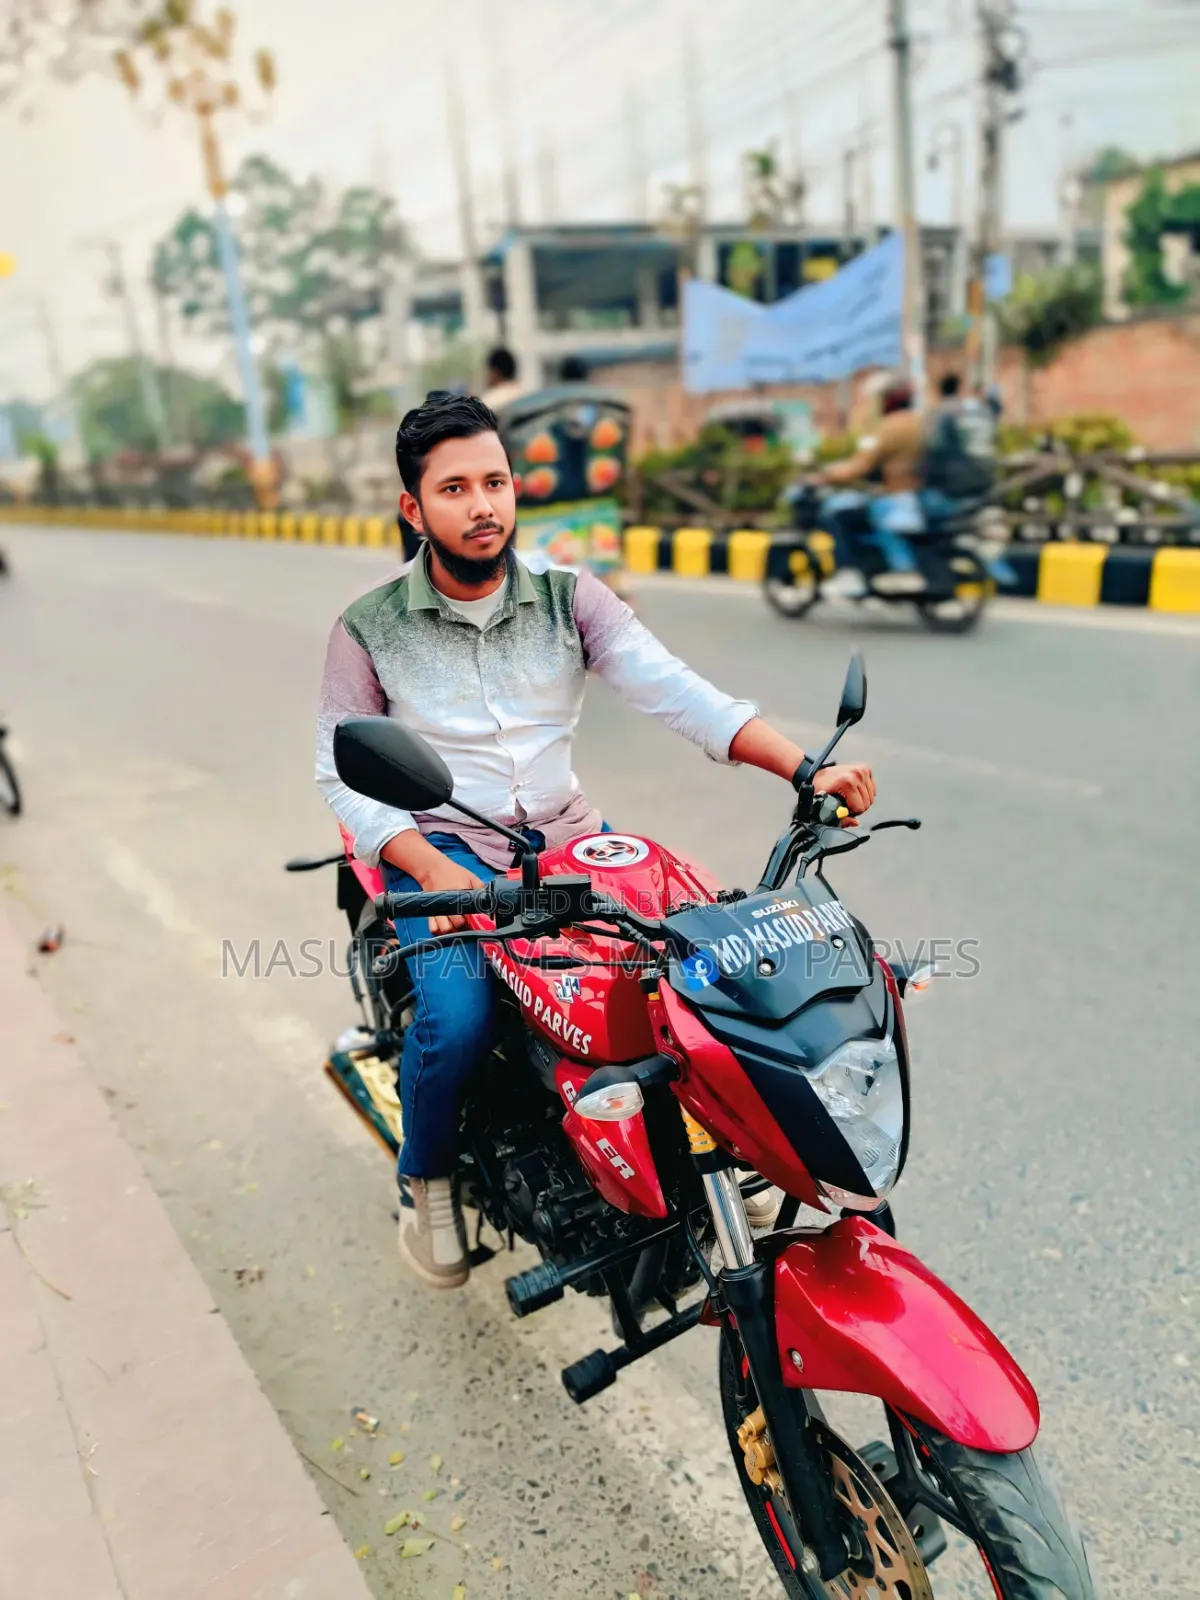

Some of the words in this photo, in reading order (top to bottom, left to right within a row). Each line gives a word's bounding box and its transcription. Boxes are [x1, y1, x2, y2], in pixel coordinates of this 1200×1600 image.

[752, 900, 799, 919] SUZUKI
[710, 934, 752, 974] MD
[744, 913, 814, 957] MASUD
[533, 995, 592, 1055] PARVES
